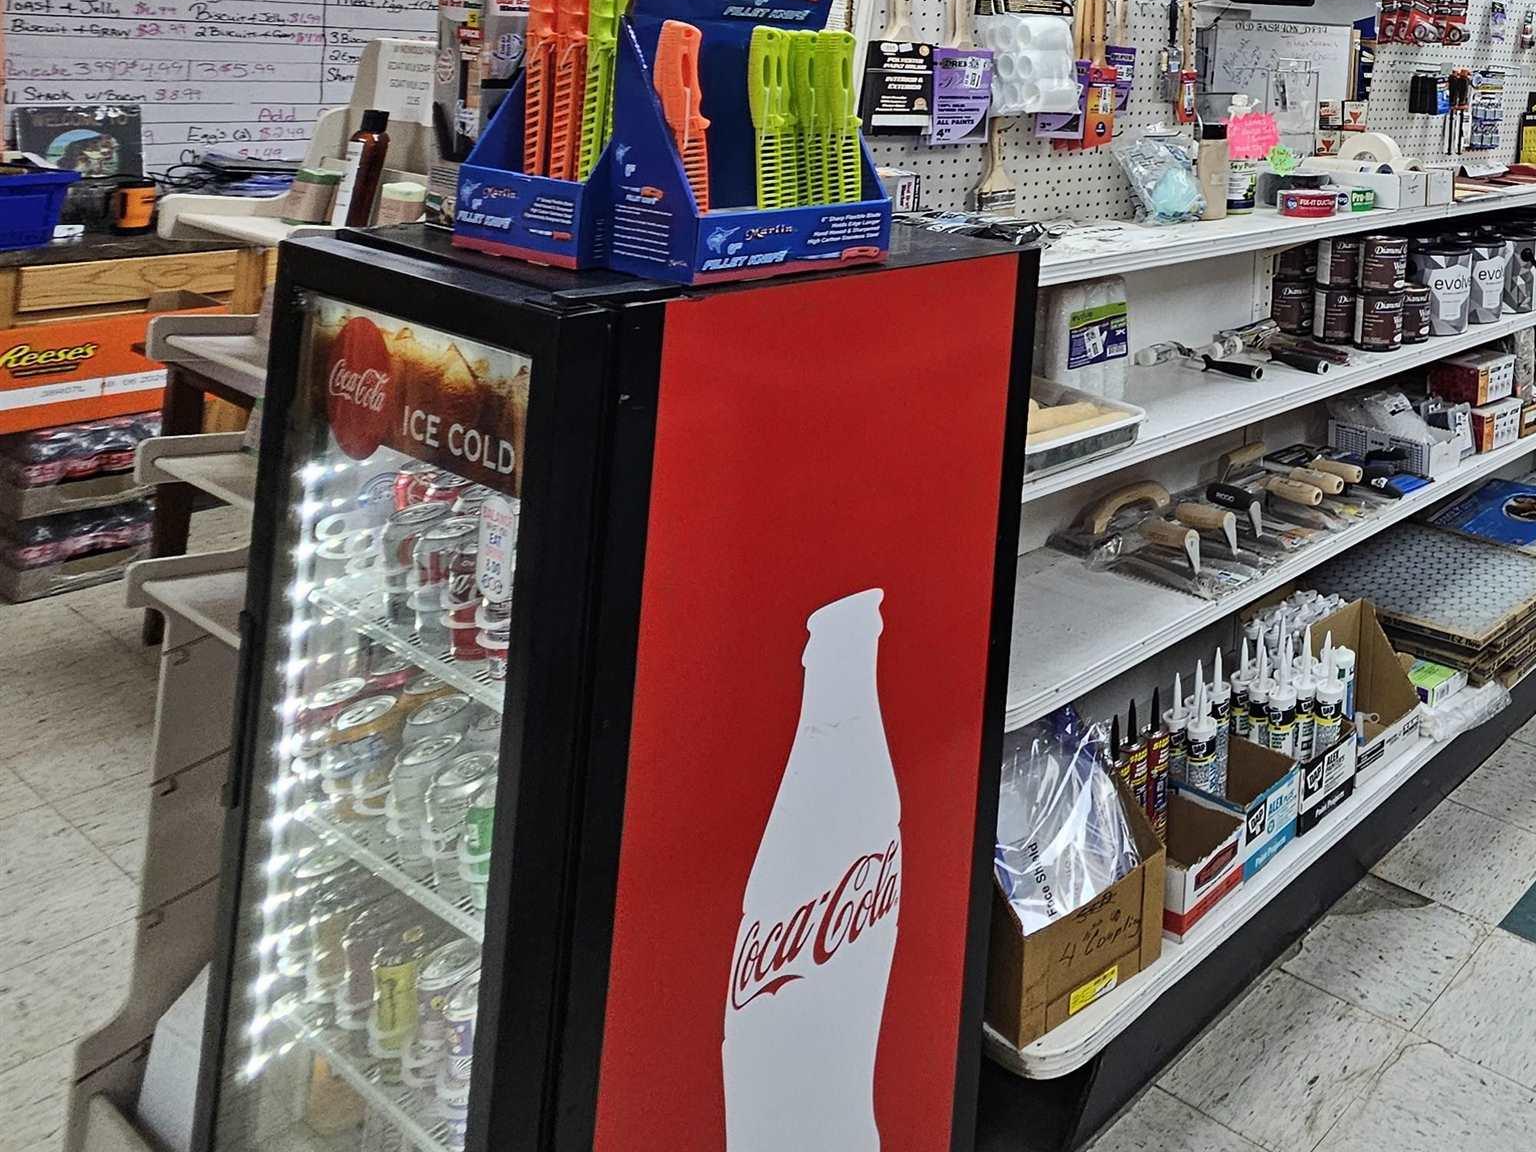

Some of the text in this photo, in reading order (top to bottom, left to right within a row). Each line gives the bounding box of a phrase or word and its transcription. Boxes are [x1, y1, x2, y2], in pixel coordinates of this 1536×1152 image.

[745, 222, 794, 241] Marlin
[402, 405, 516, 475] ICE COLD
[1308, 765, 1323, 786] DAP
[1248, 807, 1266, 829] DAP
[731, 838, 899, 1011] Coca-Cola
